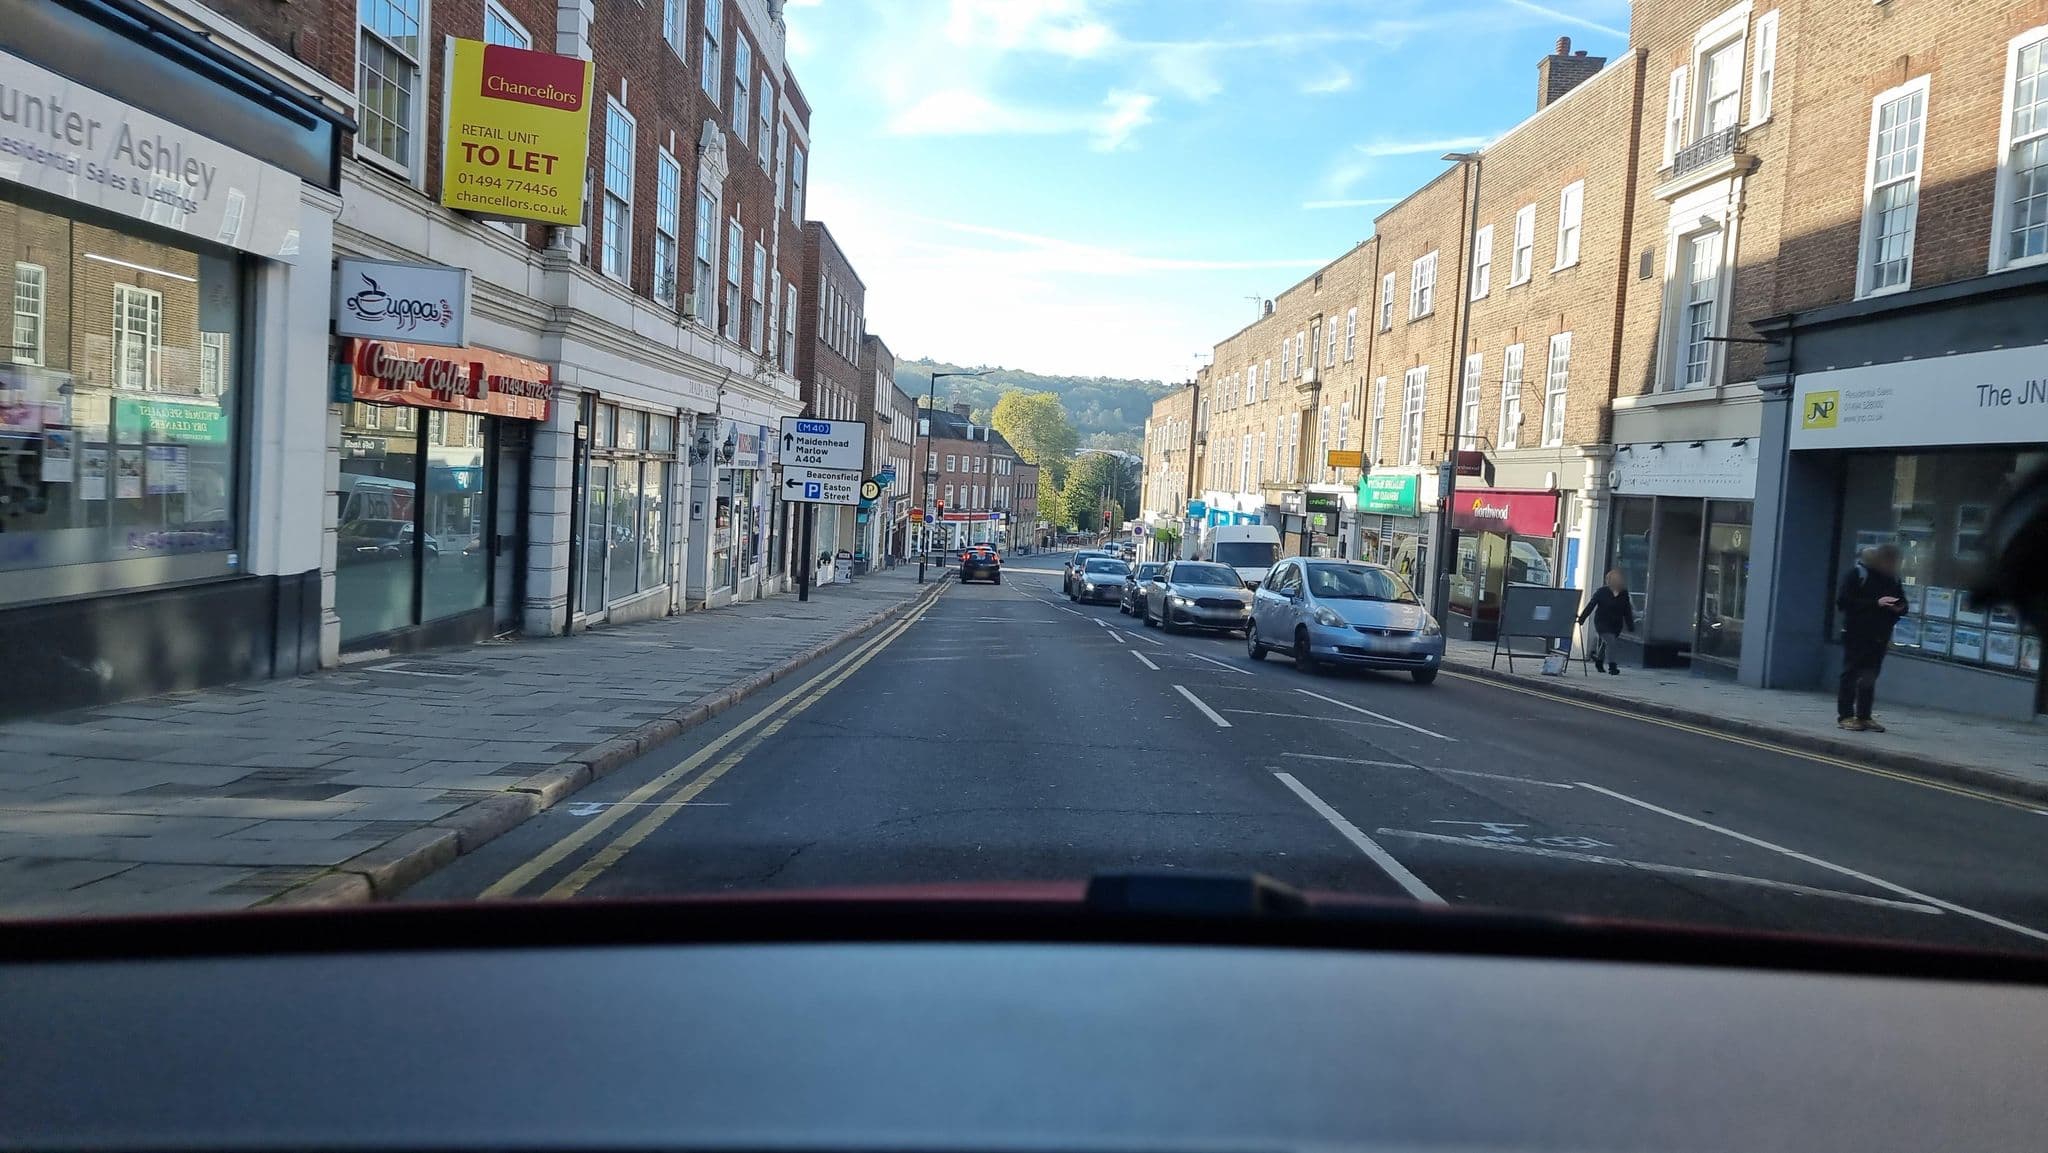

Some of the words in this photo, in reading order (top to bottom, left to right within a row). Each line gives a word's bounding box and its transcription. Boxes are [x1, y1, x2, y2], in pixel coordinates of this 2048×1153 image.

[487, 75, 577, 104] Chancellors
[0, 83, 102, 151] unter
[114, 121, 216, 200] Ashley
[462, 123, 504, 140] RETAIL
[507, 130, 539, 145] UNIT
[461, 141, 500, 166] TO
[507, 149, 559, 175] LET
[0, 137, 81, 176] esidential
[85, 161, 126, 191] Sales
[130, 177, 142, 196] &
[146, 181, 198, 215] Lettings
[458, 172, 502, 189] 01494
[506, 179, 558, 198] 774456
[456, 190, 568, 217] chancellors.co.uk
[373, 343, 425, 382] Cuppa
[429, 360, 470, 399] Coffee
[499, 376, 526, 396] 01494
[1976, 384, 2012, 407] The
[2017, 379, 2048, 405] JN
[1807, 401, 1835, 420] JNP
[795, 446, 829, 455] Marlow
[796, 436, 849, 448] Maidenhead
[795, 455, 822, 464] A404
[806, 470, 859, 482] Beaconsfield
[808, 484, 819, 497] P
[823, 483, 852, 492] Easton
[823, 491, 850, 501] Street
[1474, 503, 1509, 520] northwood
